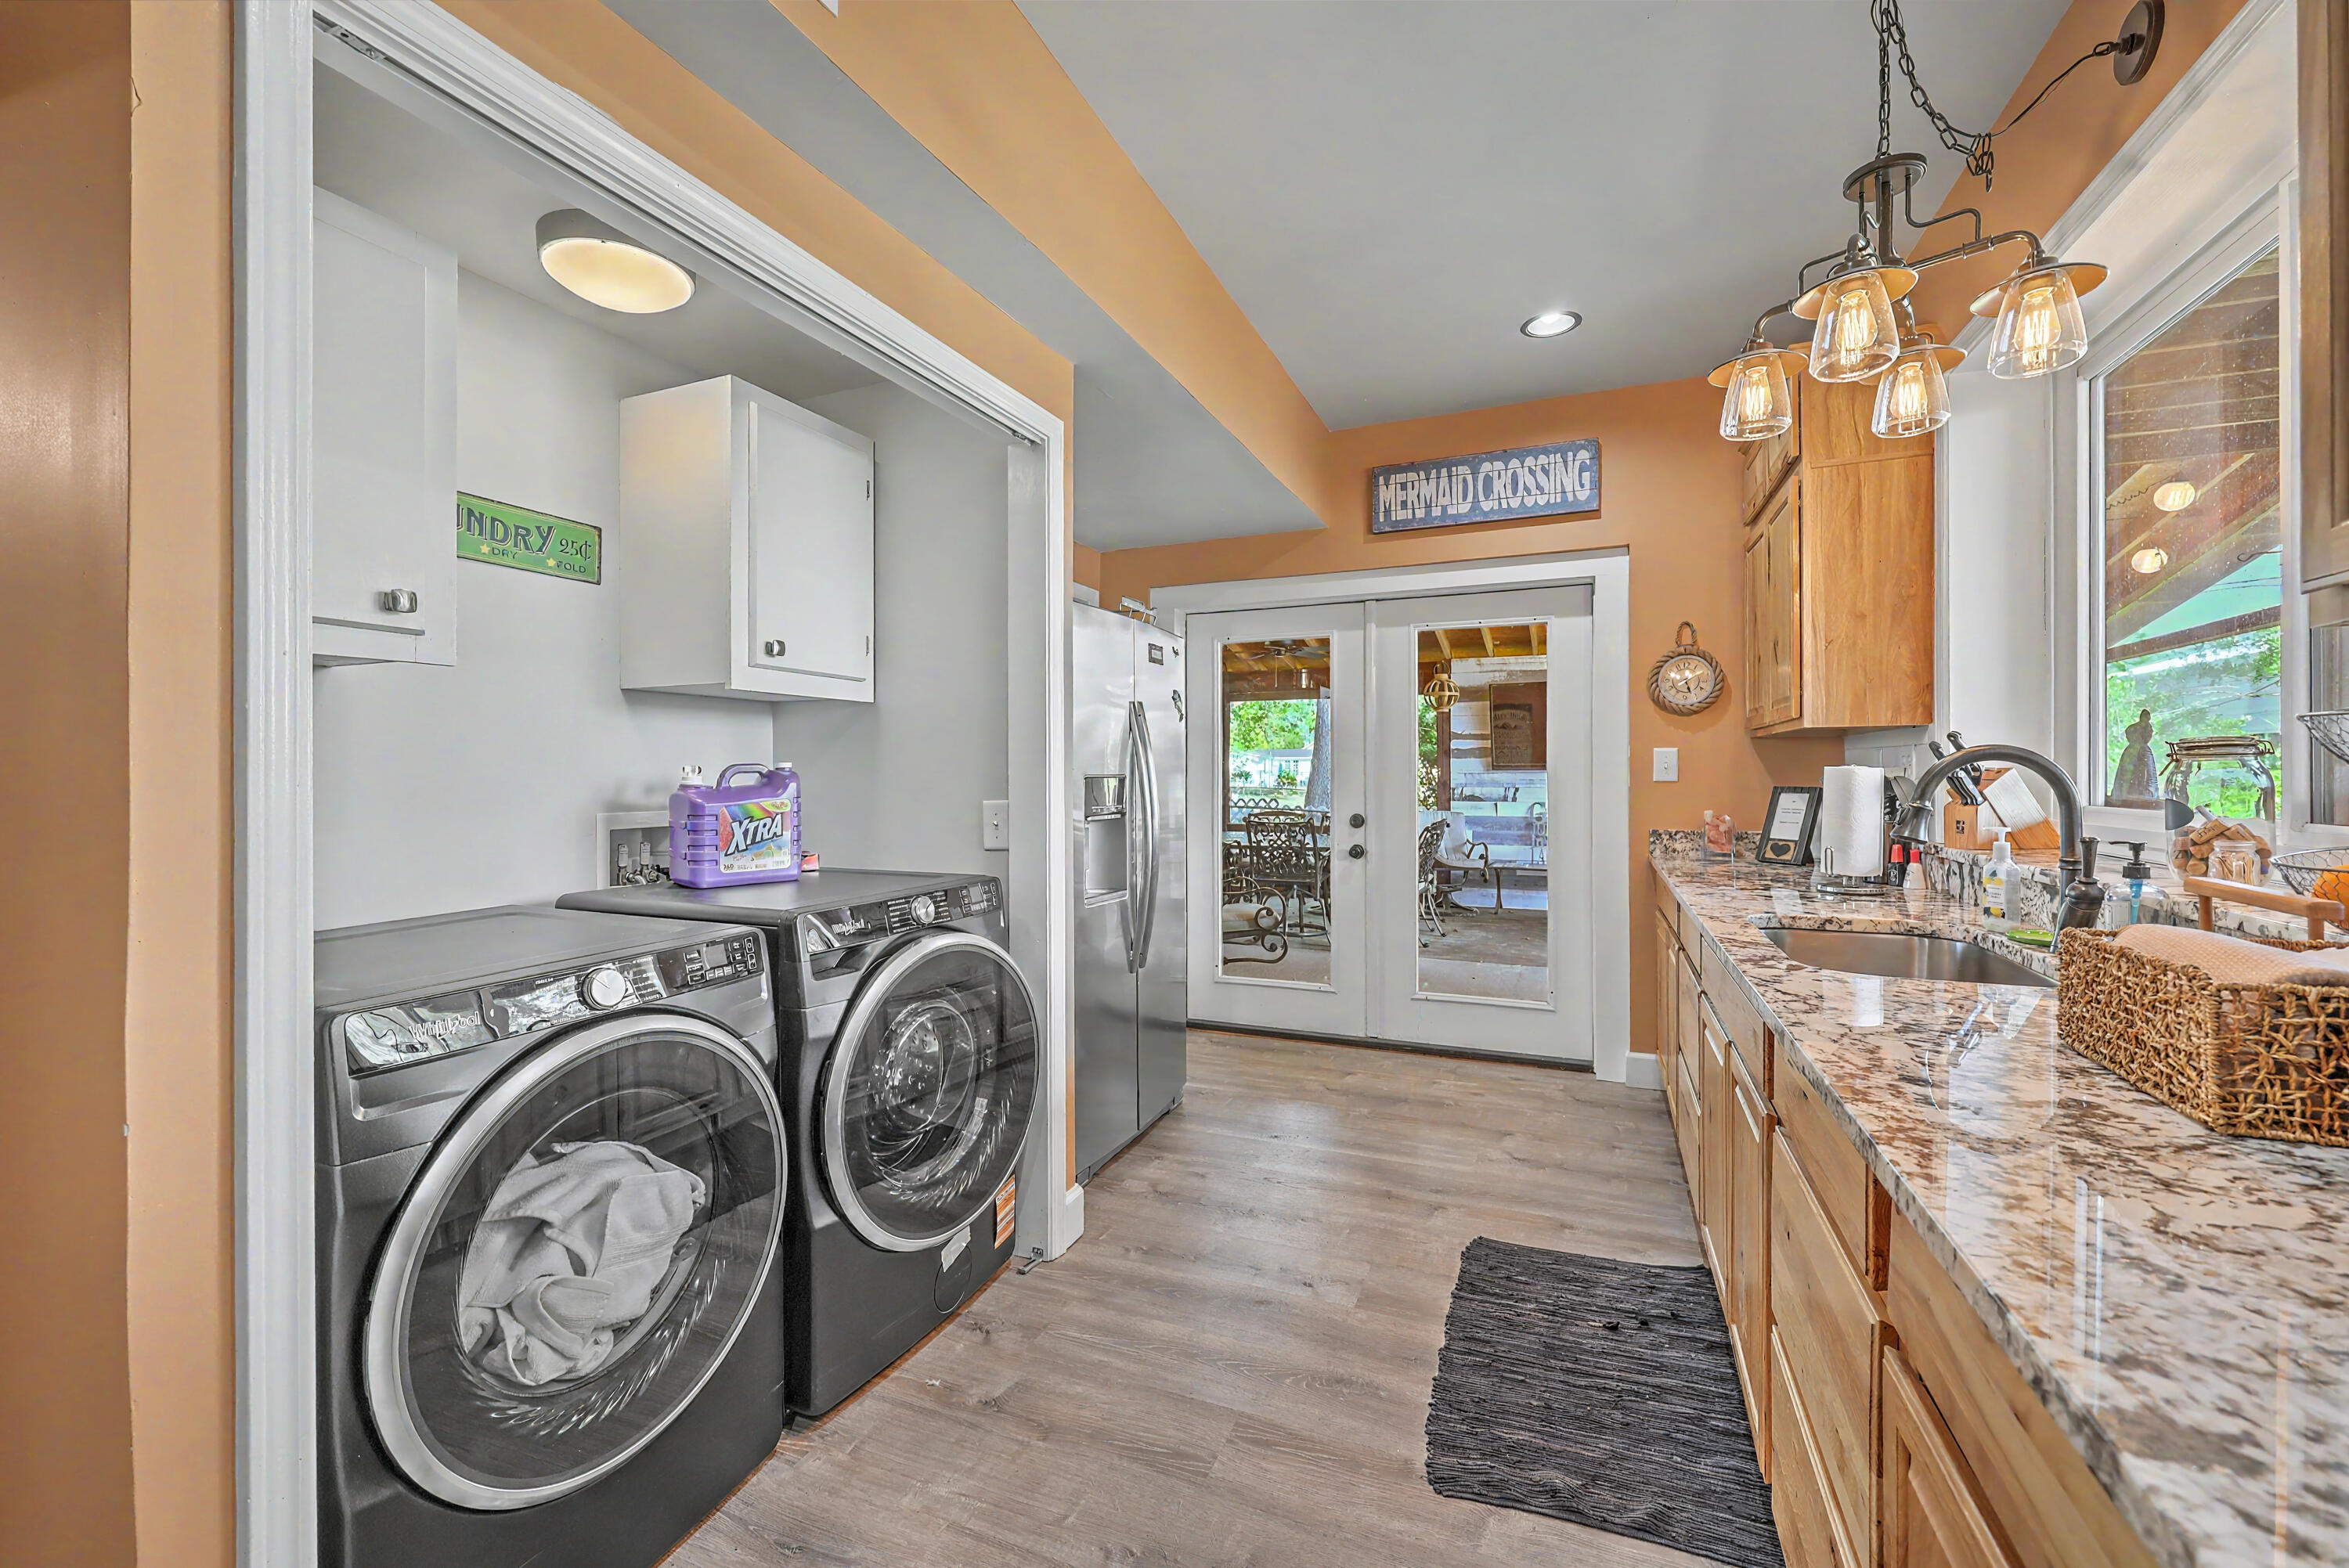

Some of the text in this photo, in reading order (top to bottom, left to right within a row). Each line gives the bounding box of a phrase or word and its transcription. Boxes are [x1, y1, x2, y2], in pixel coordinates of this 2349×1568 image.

[1379, 449, 1590, 521] MERMAID CROSSING
[456, 503, 556, 554] NDRY
[492, 547, 518, 559] DRY
[557, 561, 586, 573] FOLD
[724, 813, 783, 856] XTRA
